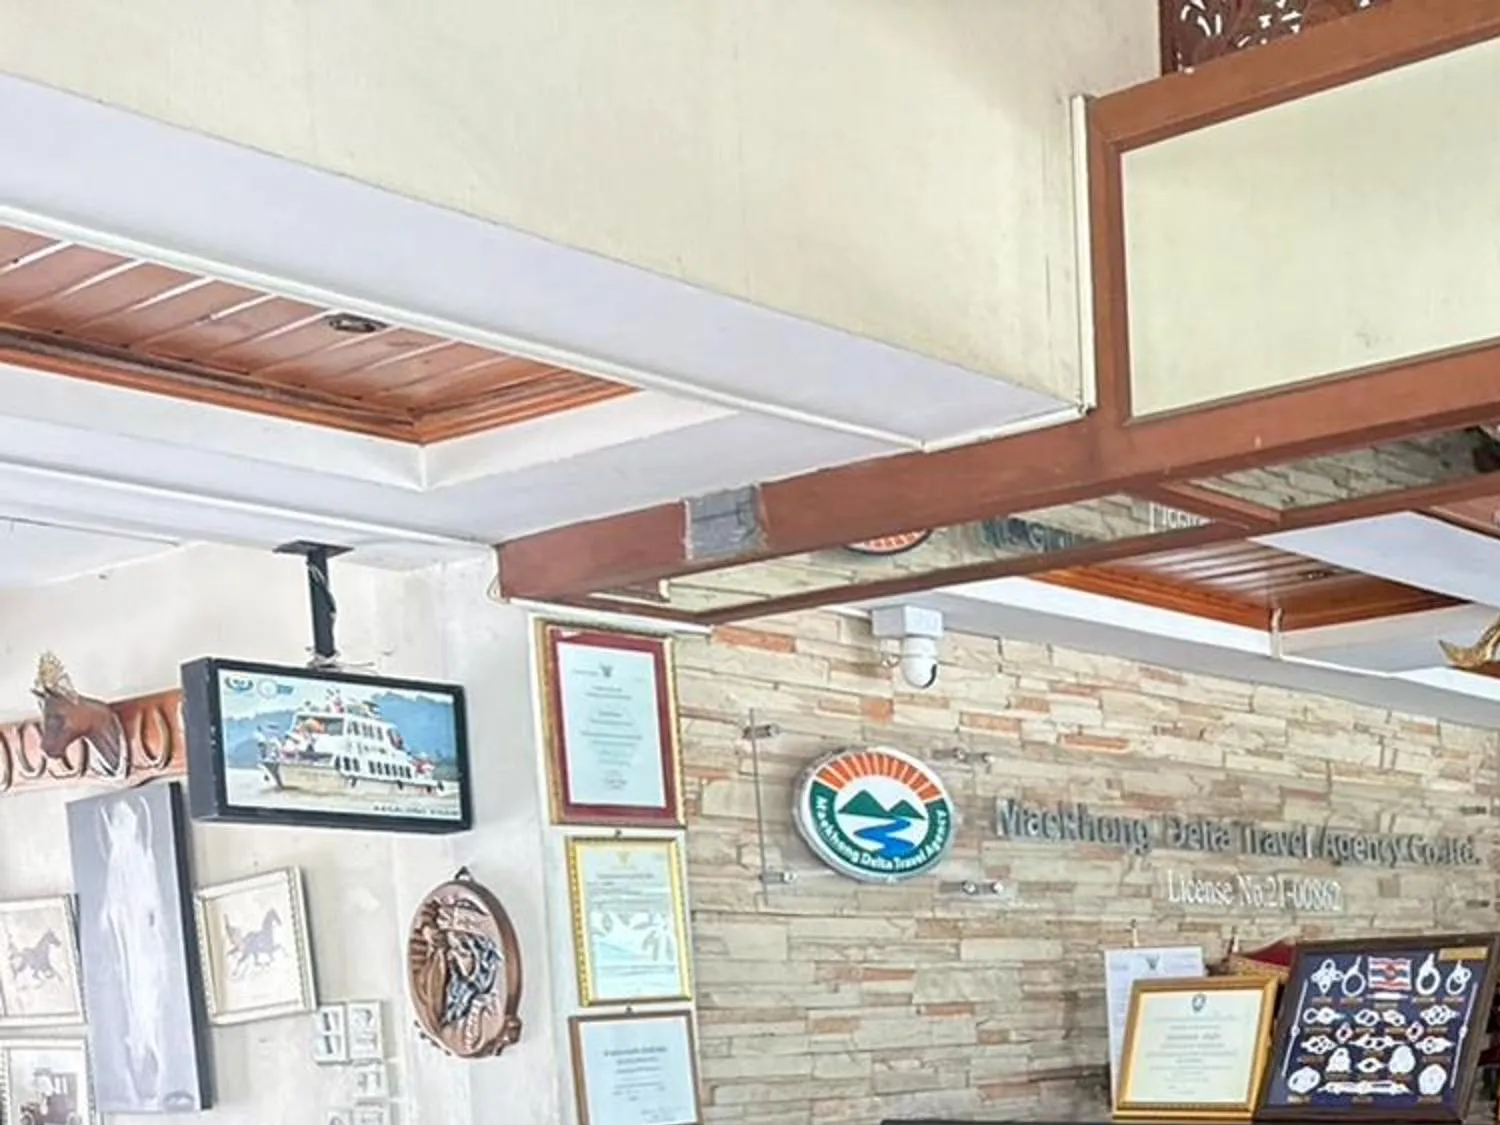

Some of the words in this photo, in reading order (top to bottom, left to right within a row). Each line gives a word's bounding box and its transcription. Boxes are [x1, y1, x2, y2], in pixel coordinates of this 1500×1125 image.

[815, 794, 860, 863] Maekhong
[861, 852, 893, 870] Delta
[892, 849, 926, 871] Travel
[925, 808, 948, 857] Agency
[1164, 813, 1232, 851] Delta
[1238, 820, 1314, 859] Travel
[1318, 825, 1401, 868] Agency
[1168, 869, 1234, 905] License
